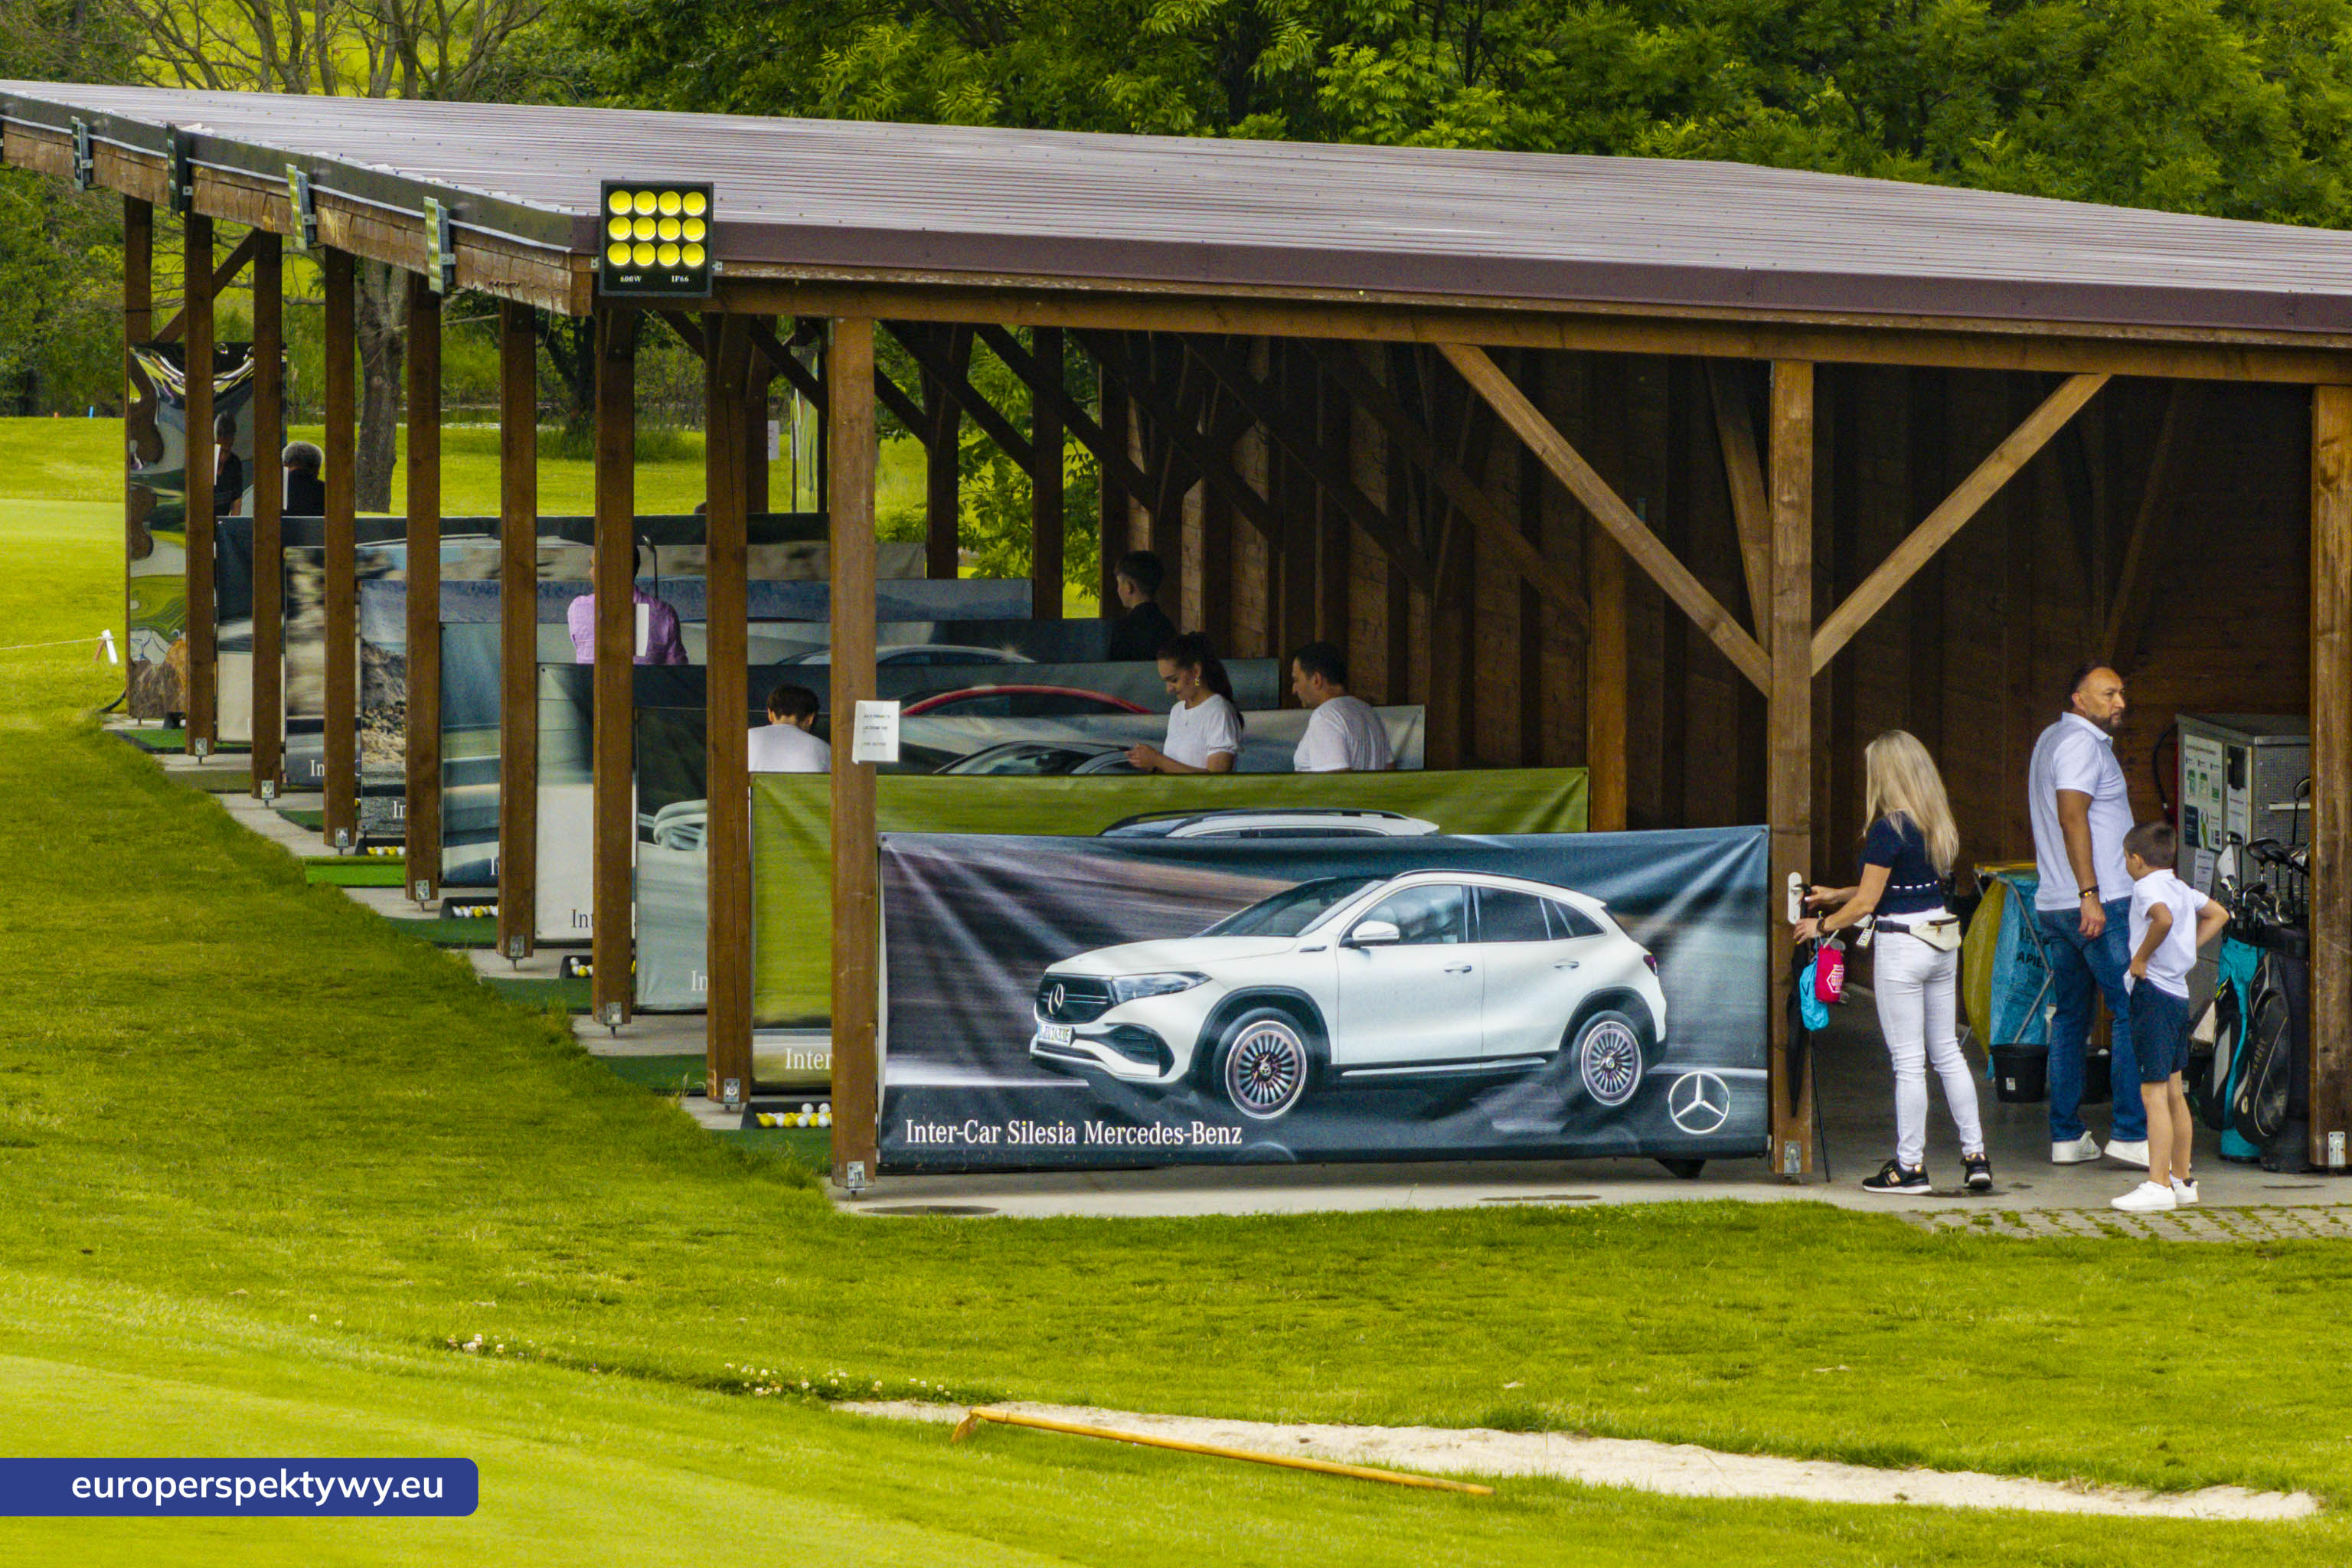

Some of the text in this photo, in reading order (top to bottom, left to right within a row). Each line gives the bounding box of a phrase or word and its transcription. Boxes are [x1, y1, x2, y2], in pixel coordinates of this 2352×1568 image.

[906, 1119, 1243, 1145] Inter-Car Silesia Mercedes-Benz
